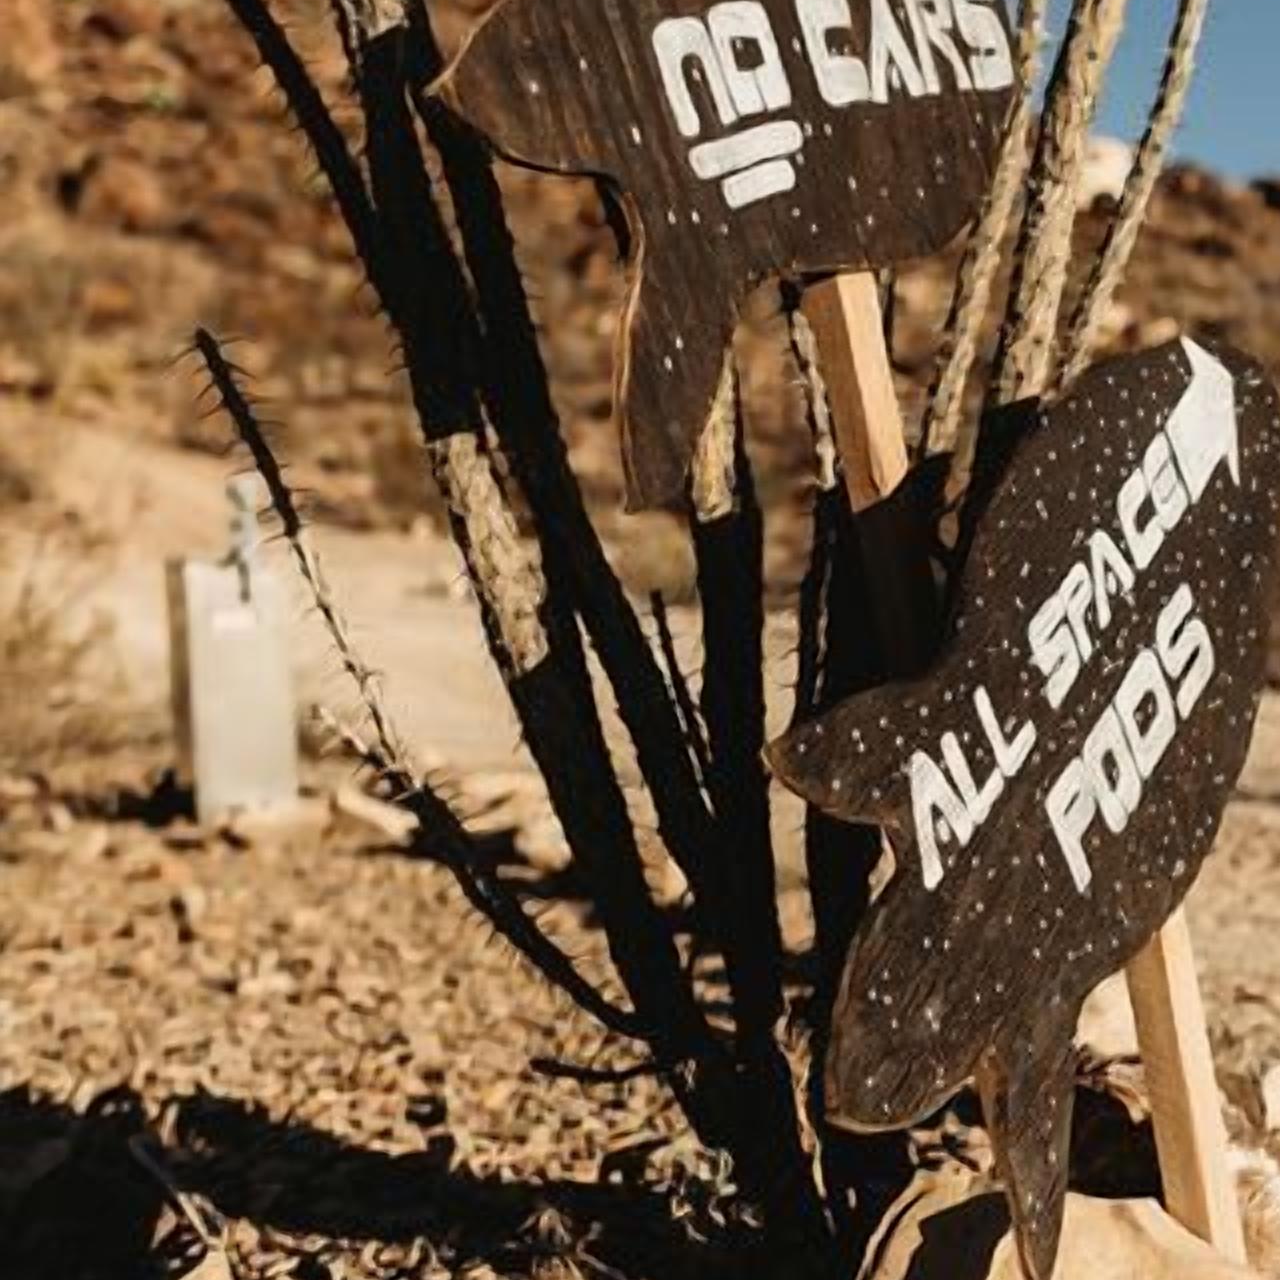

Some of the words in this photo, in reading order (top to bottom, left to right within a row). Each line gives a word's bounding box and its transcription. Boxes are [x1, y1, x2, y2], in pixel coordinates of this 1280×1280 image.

[652, 0, 792, 137] NO
[910, 685, 1036, 890] ALL
[1045, 583, 1215, 893] PODS
